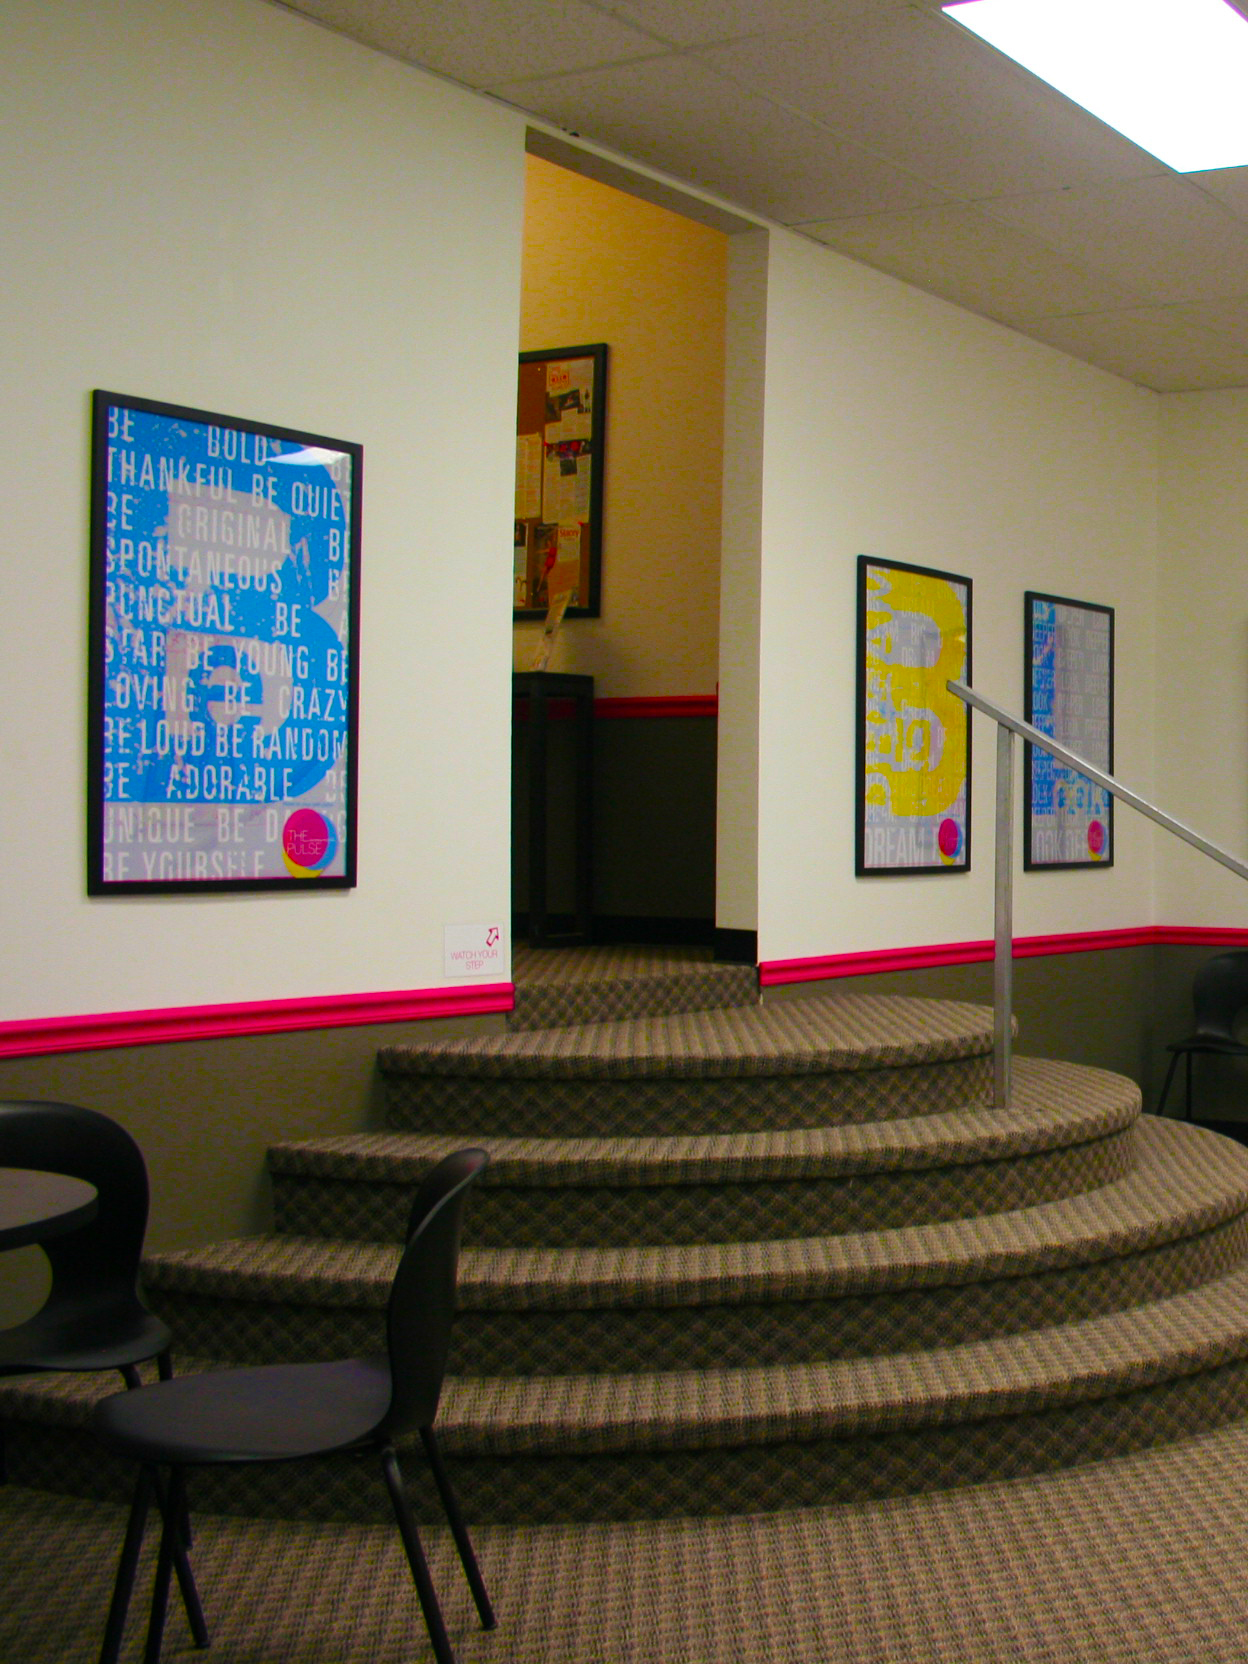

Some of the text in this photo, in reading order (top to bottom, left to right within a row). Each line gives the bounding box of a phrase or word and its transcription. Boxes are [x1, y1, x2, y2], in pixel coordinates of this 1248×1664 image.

[207, 425, 268, 467] BOLD
[107, 446, 238, 504] THANKFUL
[251, 473, 279, 511] BE
[177, 503, 291, 555] ORIGINAL
[105, 536, 283, 595] SPONTANEOUS
[275, 601, 302, 638] BE
[186, 633, 215, 672] BE
[233, 639, 309, 680] YOUNG
[224, 680, 252, 717] BE
[140, 718, 206, 757] LOUD
[215, 723, 243, 758] BE
[166, 764, 294, 802] ADORABLE
[217, 807, 245, 844] BE
[287, 829, 308, 843] THE
[286, 842, 322, 855] PULSE
[450, 949, 498, 960] WATCH YOUR
[465, 960, 484, 970] STEP
